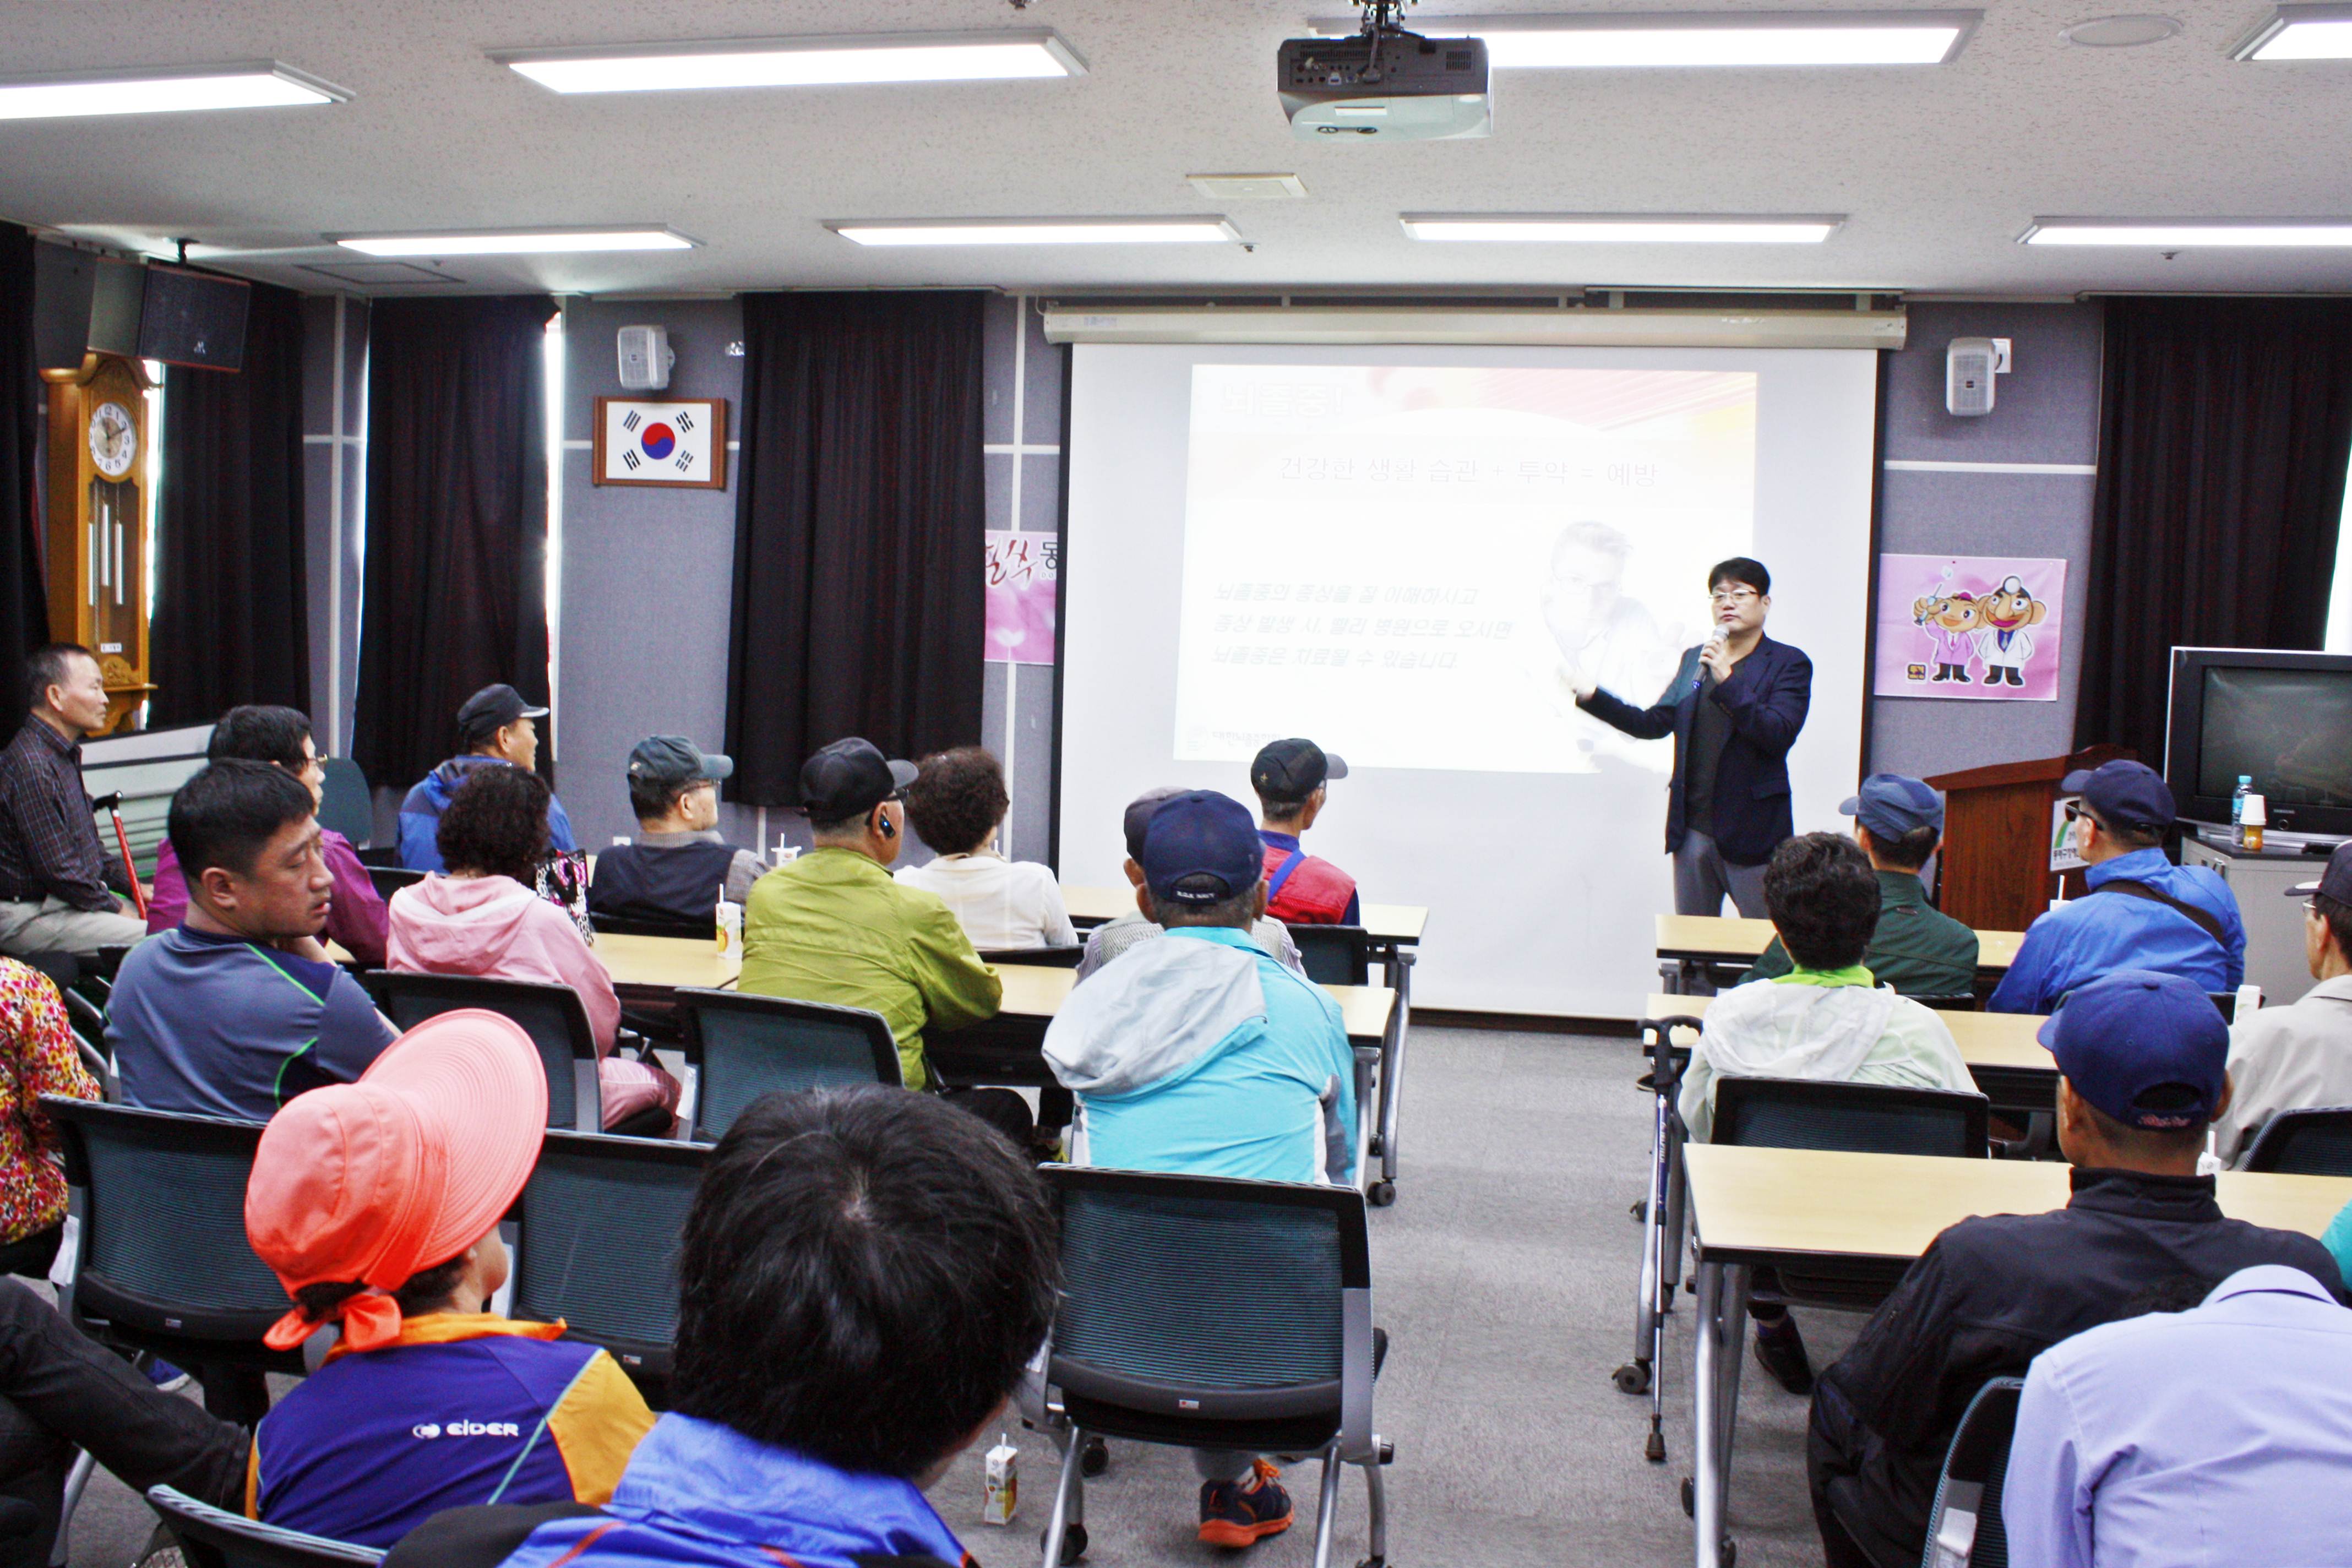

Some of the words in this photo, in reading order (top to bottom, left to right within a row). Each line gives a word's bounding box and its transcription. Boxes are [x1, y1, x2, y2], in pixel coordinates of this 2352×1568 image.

[1279, 456, 1355, 481] 건강한
[1368, 457, 1417, 482] 생활
[1428, 458, 1479, 483] 습관
[1517, 460, 1569, 485] 투약
[1608, 462, 1660, 488] 예방
[1213, 581, 1291, 602] 뇌졸중의
[1357, 584, 1378, 605] 잘
[1384, 585, 1480, 606] 이해하시고
[1213, 613, 1252, 634] 증상
[1256, 614, 1294, 634] 발생
[1329, 616, 1366, 636] 빨리
[1373, 617, 1449, 638] 병원으로
[1454, 619, 1516, 640] 오시면
[1211, 645, 1287, 665] 뇌졸중은
[1355, 649, 1375, 669] 수
